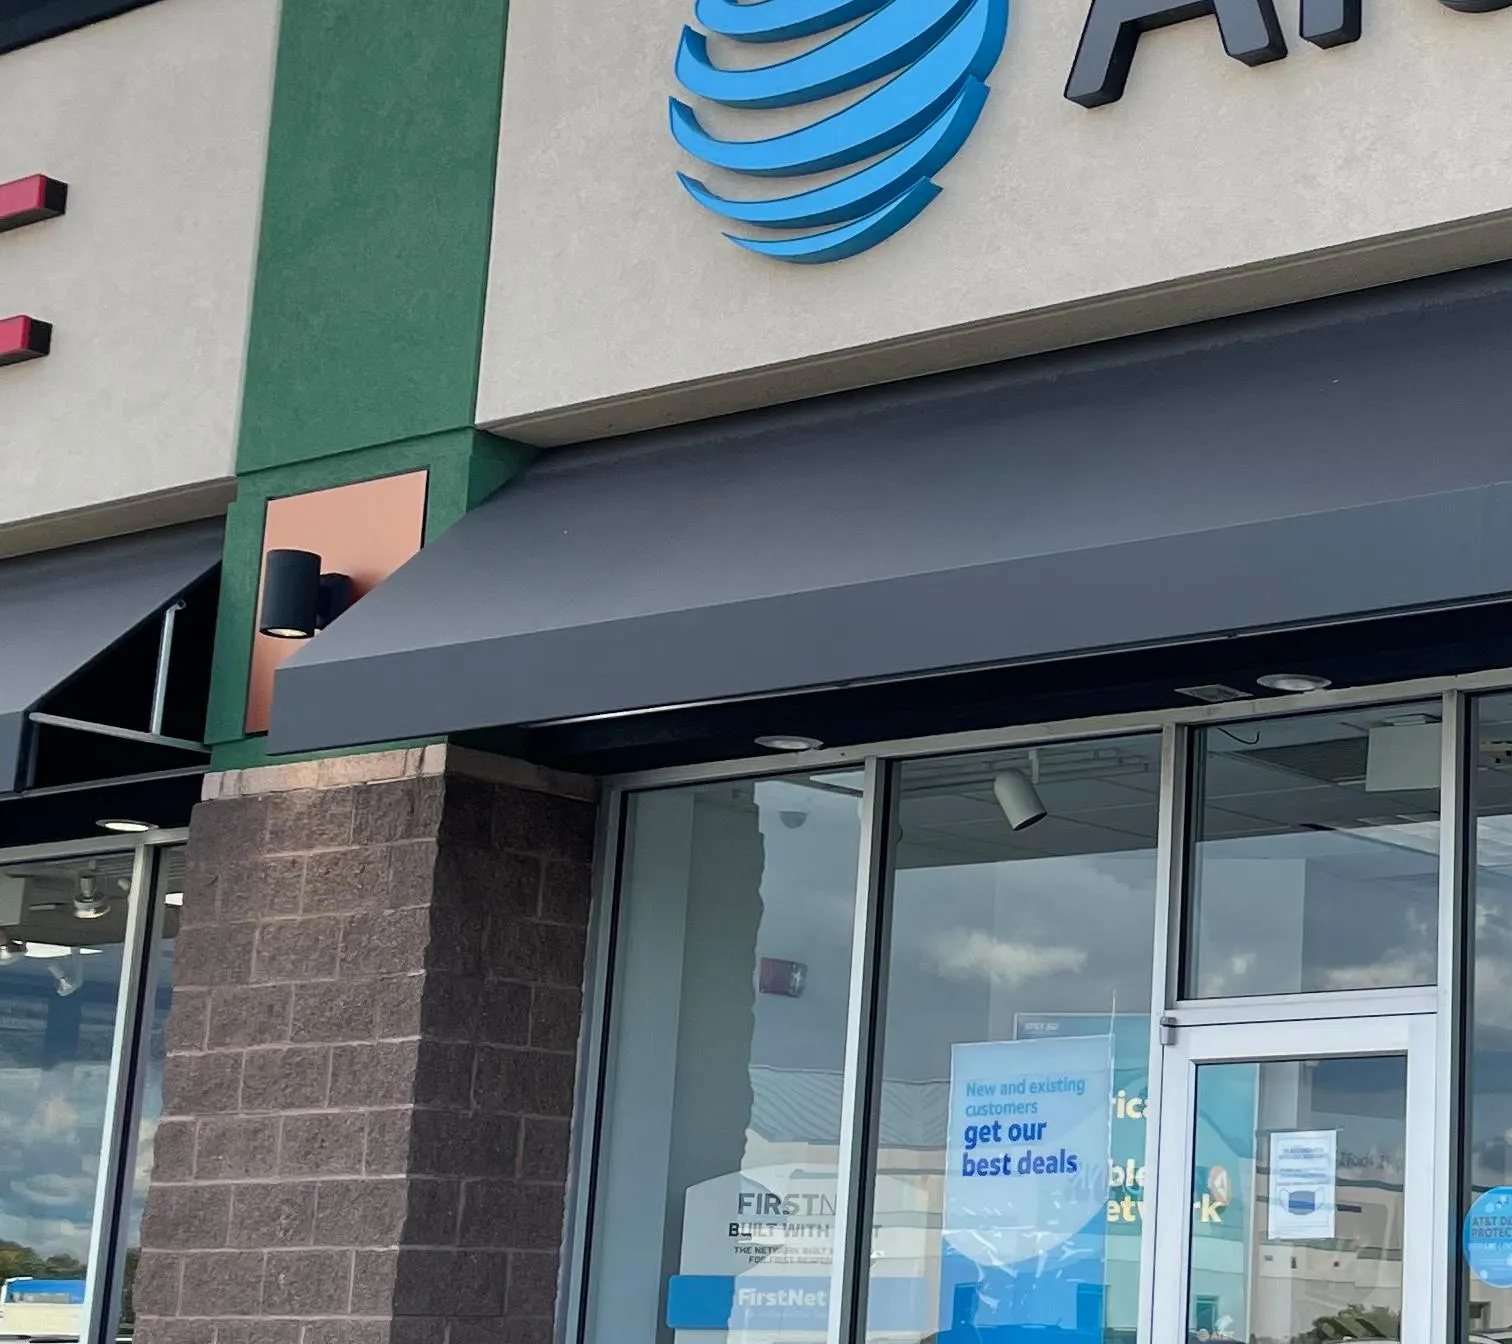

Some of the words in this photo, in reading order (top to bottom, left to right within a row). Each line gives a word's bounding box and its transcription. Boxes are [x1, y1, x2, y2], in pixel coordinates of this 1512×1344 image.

[966, 1081, 995, 1097] New
[1000, 1078, 1026, 1096] and
[1029, 1076, 1086, 1096] existing
[965, 1099, 1038, 1118] customers
[964, 1120, 1002, 1150] get
[1008, 1121, 1048, 1142] our
[962, 1151, 1012, 1177] best
[1017, 1148, 1079, 1176] deals
[737, 1193, 837, 1216] FIRSTN
[728, 1222, 775, 1237] BUILT
[784, 1223, 830, 1237] WITH
[1472, 1216, 1496, 1226] AT&T
[738, 1288, 828, 1307] FirstNet
